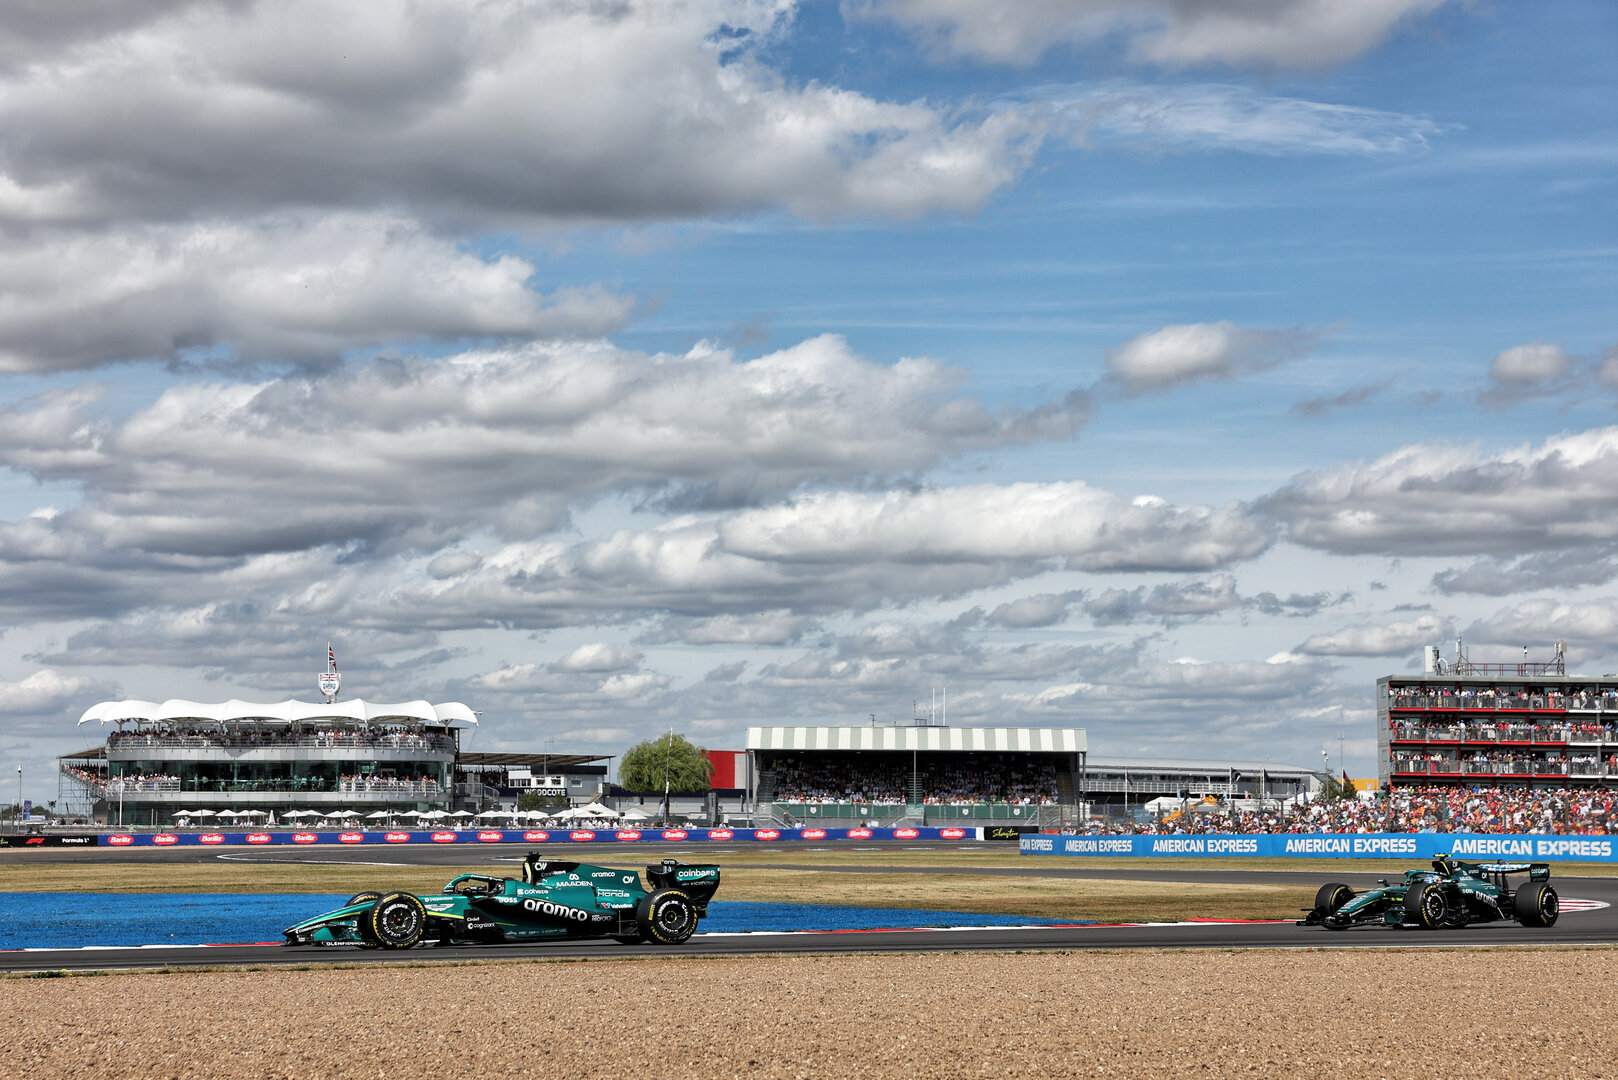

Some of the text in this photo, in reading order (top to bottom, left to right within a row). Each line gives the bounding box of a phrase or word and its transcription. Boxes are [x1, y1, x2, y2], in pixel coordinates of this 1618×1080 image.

[1032, 838, 1053, 850] EXPRESS
[1064, 840, 1132, 852] AMERICAN EXPRESS
[1152, 840, 1258, 852] AMERICAN EXPRESS
[1286, 839, 1416, 853] AMERICAN EXPRESS
[1451, 839, 1612, 856] AMERICAN EXPRESS
[678, 869, 715, 877] coinbase
[524, 899, 588, 921] aramco
